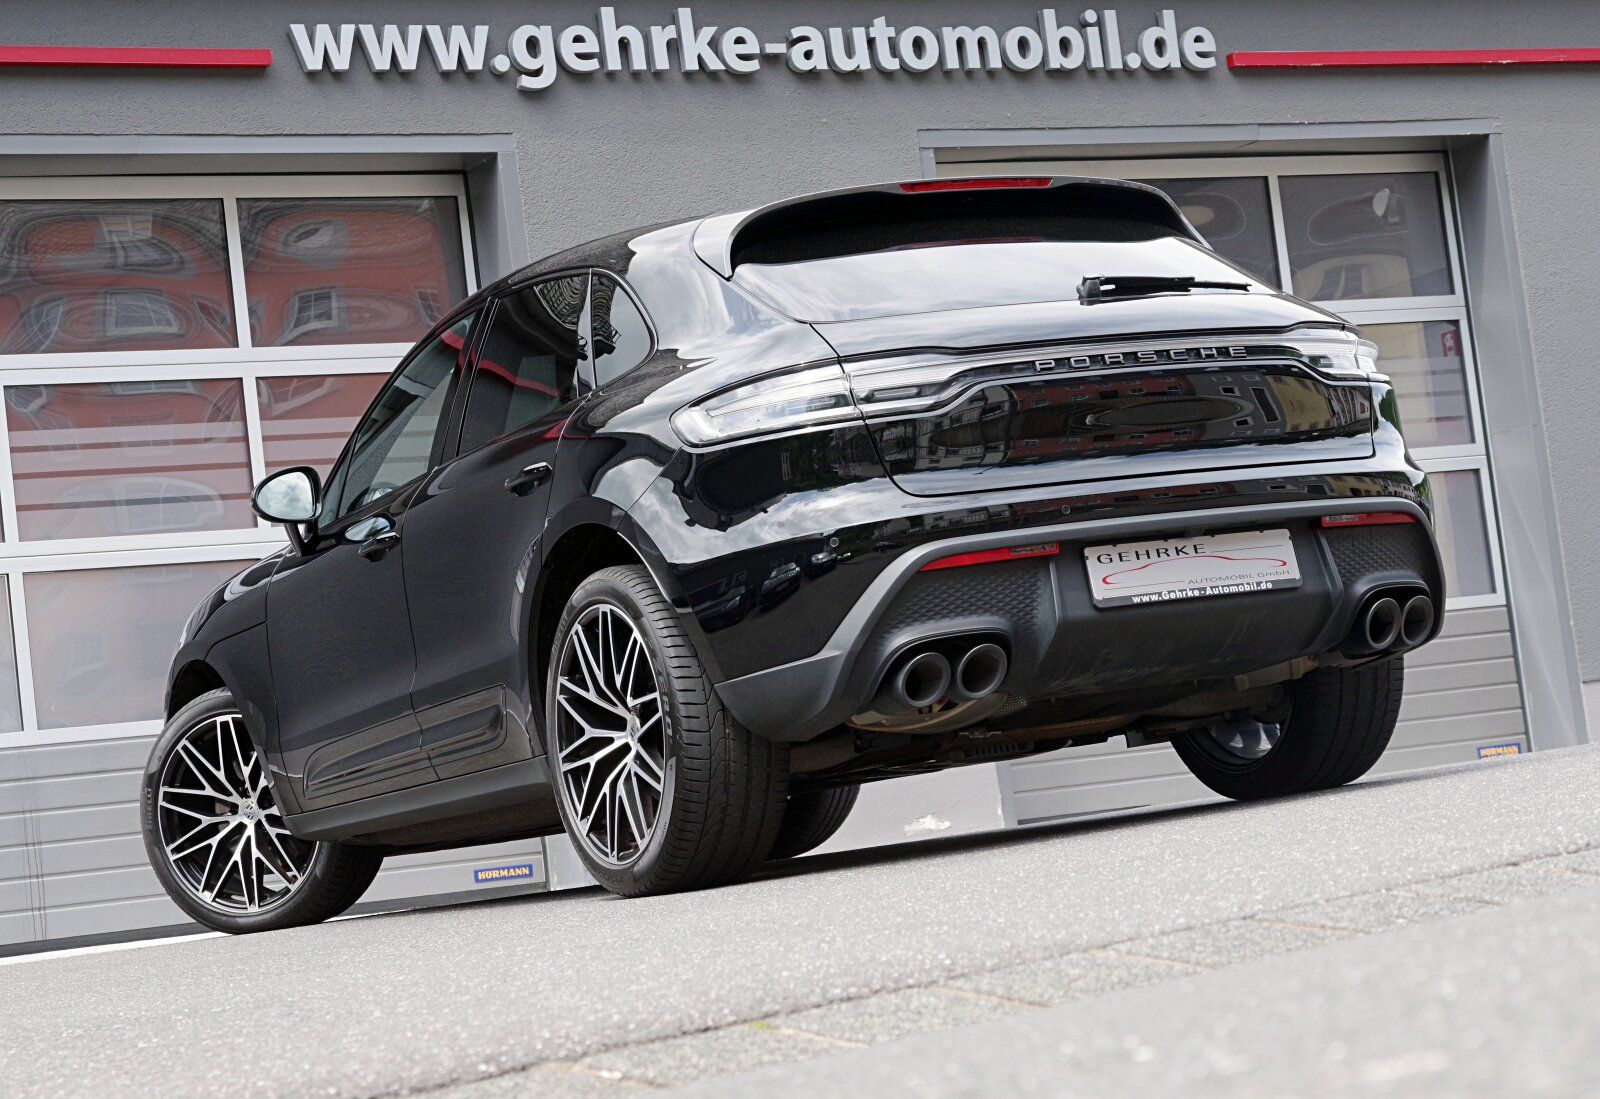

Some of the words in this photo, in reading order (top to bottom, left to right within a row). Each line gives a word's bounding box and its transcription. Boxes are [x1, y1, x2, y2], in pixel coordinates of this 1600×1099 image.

[289, 6, 1217, 91] www.gehrke-automobil.de
[1034, 346, 1248, 373] PORSCHE
[1096, 543, 1207, 565] GEHRKE
[1187, 573, 1255, 585] AUTOMOBIL
[1257, 569, 1291, 579] GmbH
